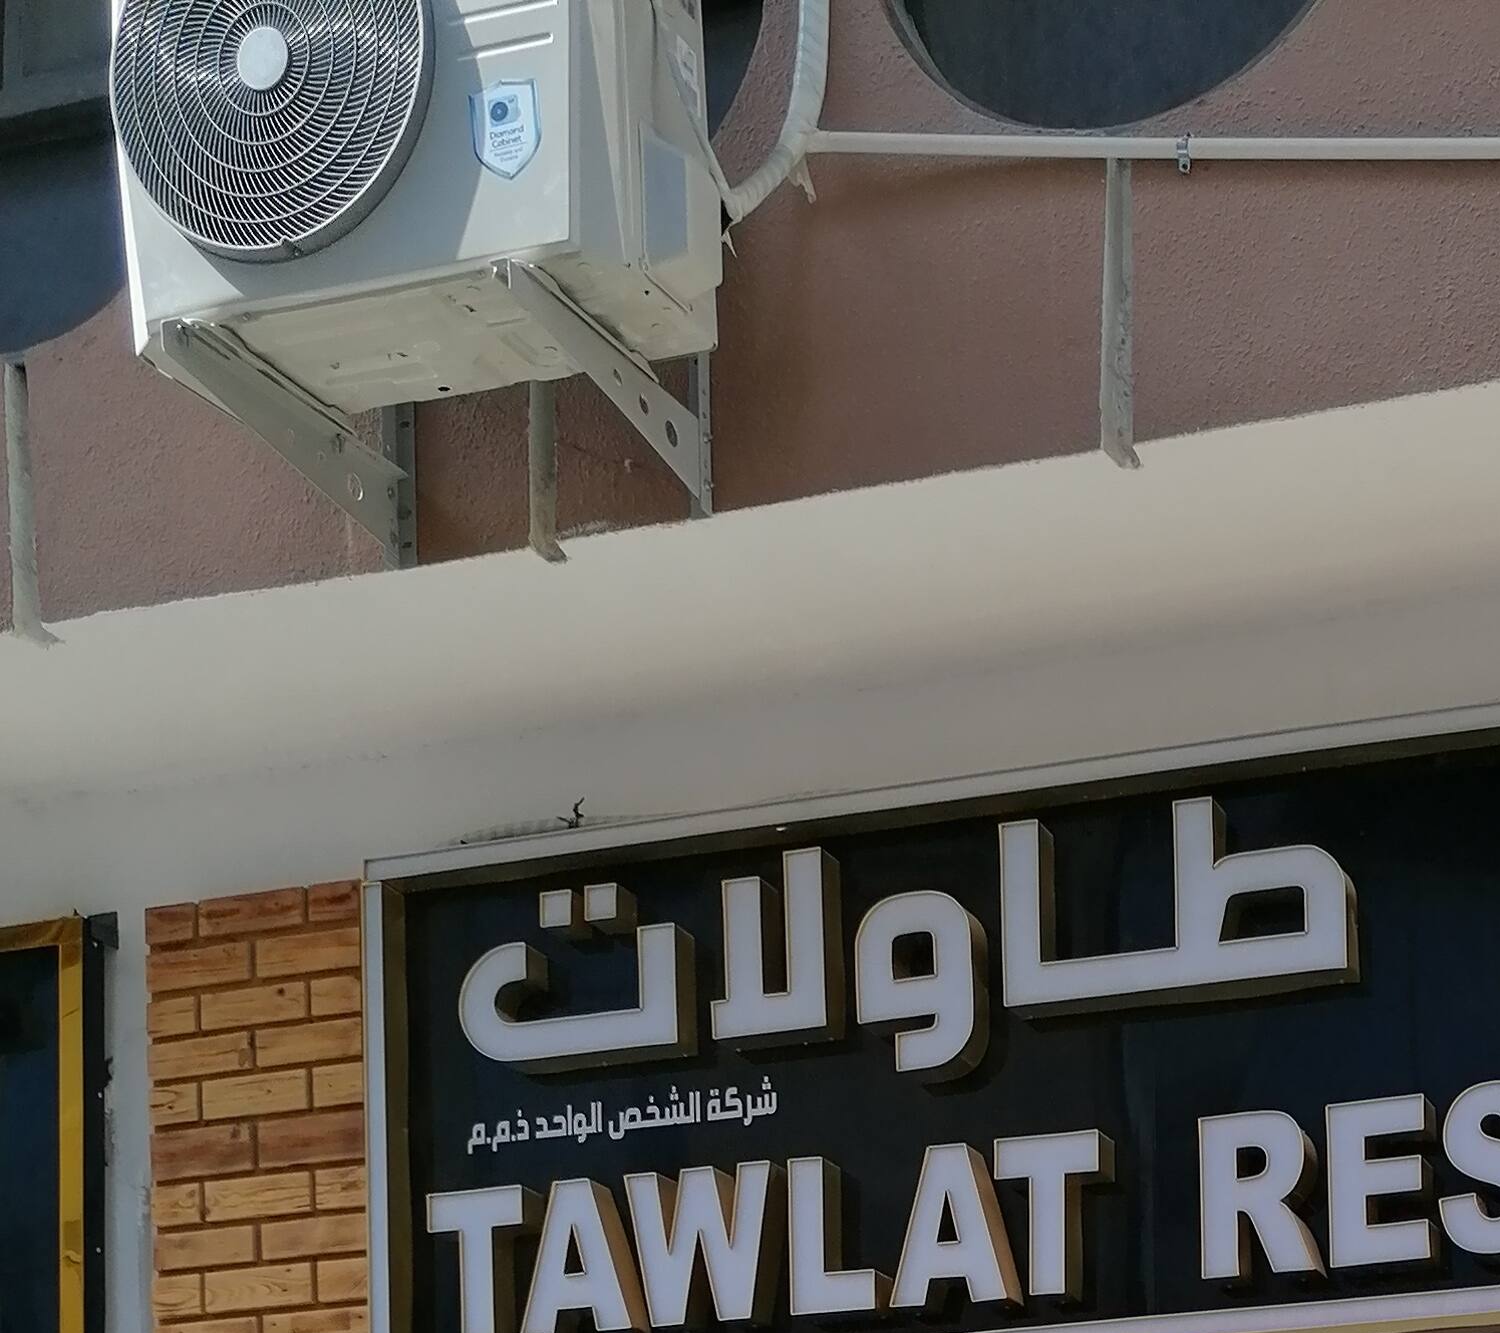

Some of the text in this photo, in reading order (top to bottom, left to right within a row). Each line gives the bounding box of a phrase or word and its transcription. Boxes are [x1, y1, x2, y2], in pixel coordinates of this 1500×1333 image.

[458, 796, 1351, 1073] طاولات
[534, 1101, 602, 1144] الواحد
[607, 1085, 701, 1140] الشخص
[706, 1075, 778, 1127] شركة
